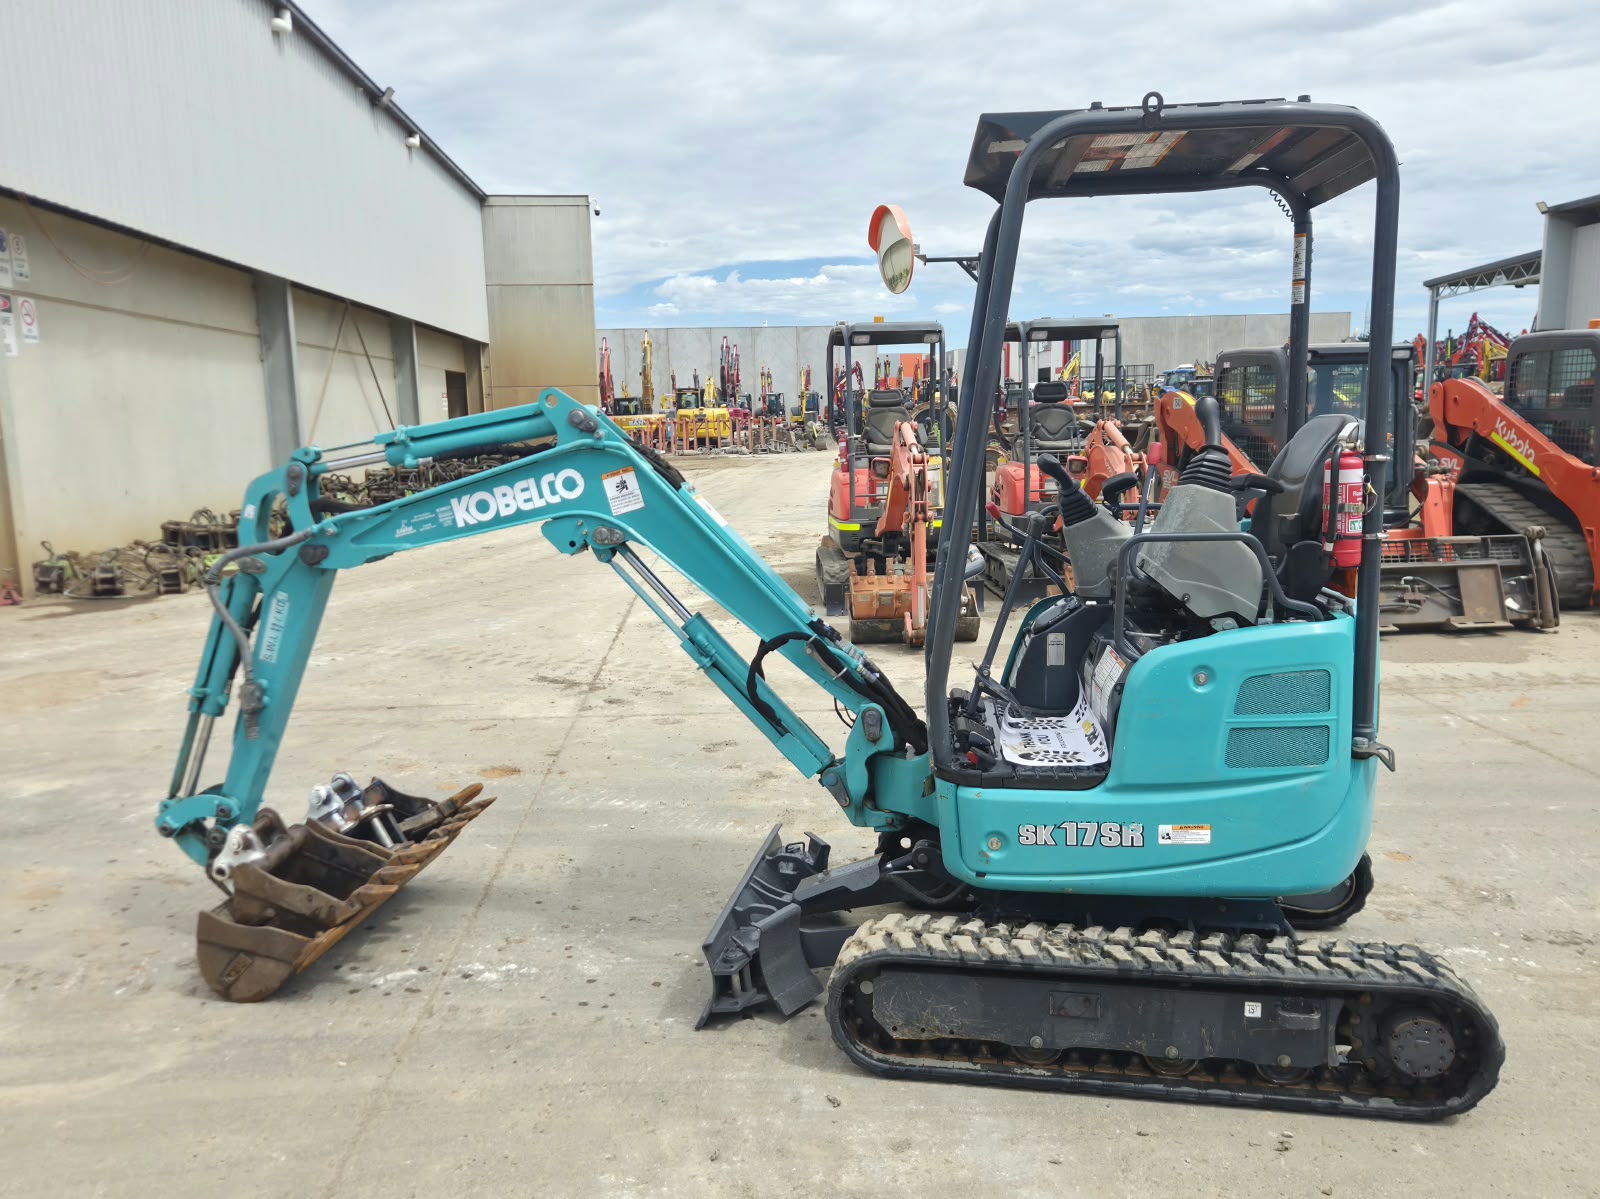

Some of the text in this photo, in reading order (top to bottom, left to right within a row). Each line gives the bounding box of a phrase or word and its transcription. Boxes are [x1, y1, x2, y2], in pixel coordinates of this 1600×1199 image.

[1495, 416, 1535, 464] Kubota
[1163, 469, 1178, 481] SVL
[1440, 457, 1461, 470] SVL
[450, 468, 585, 528] KOBELCO
